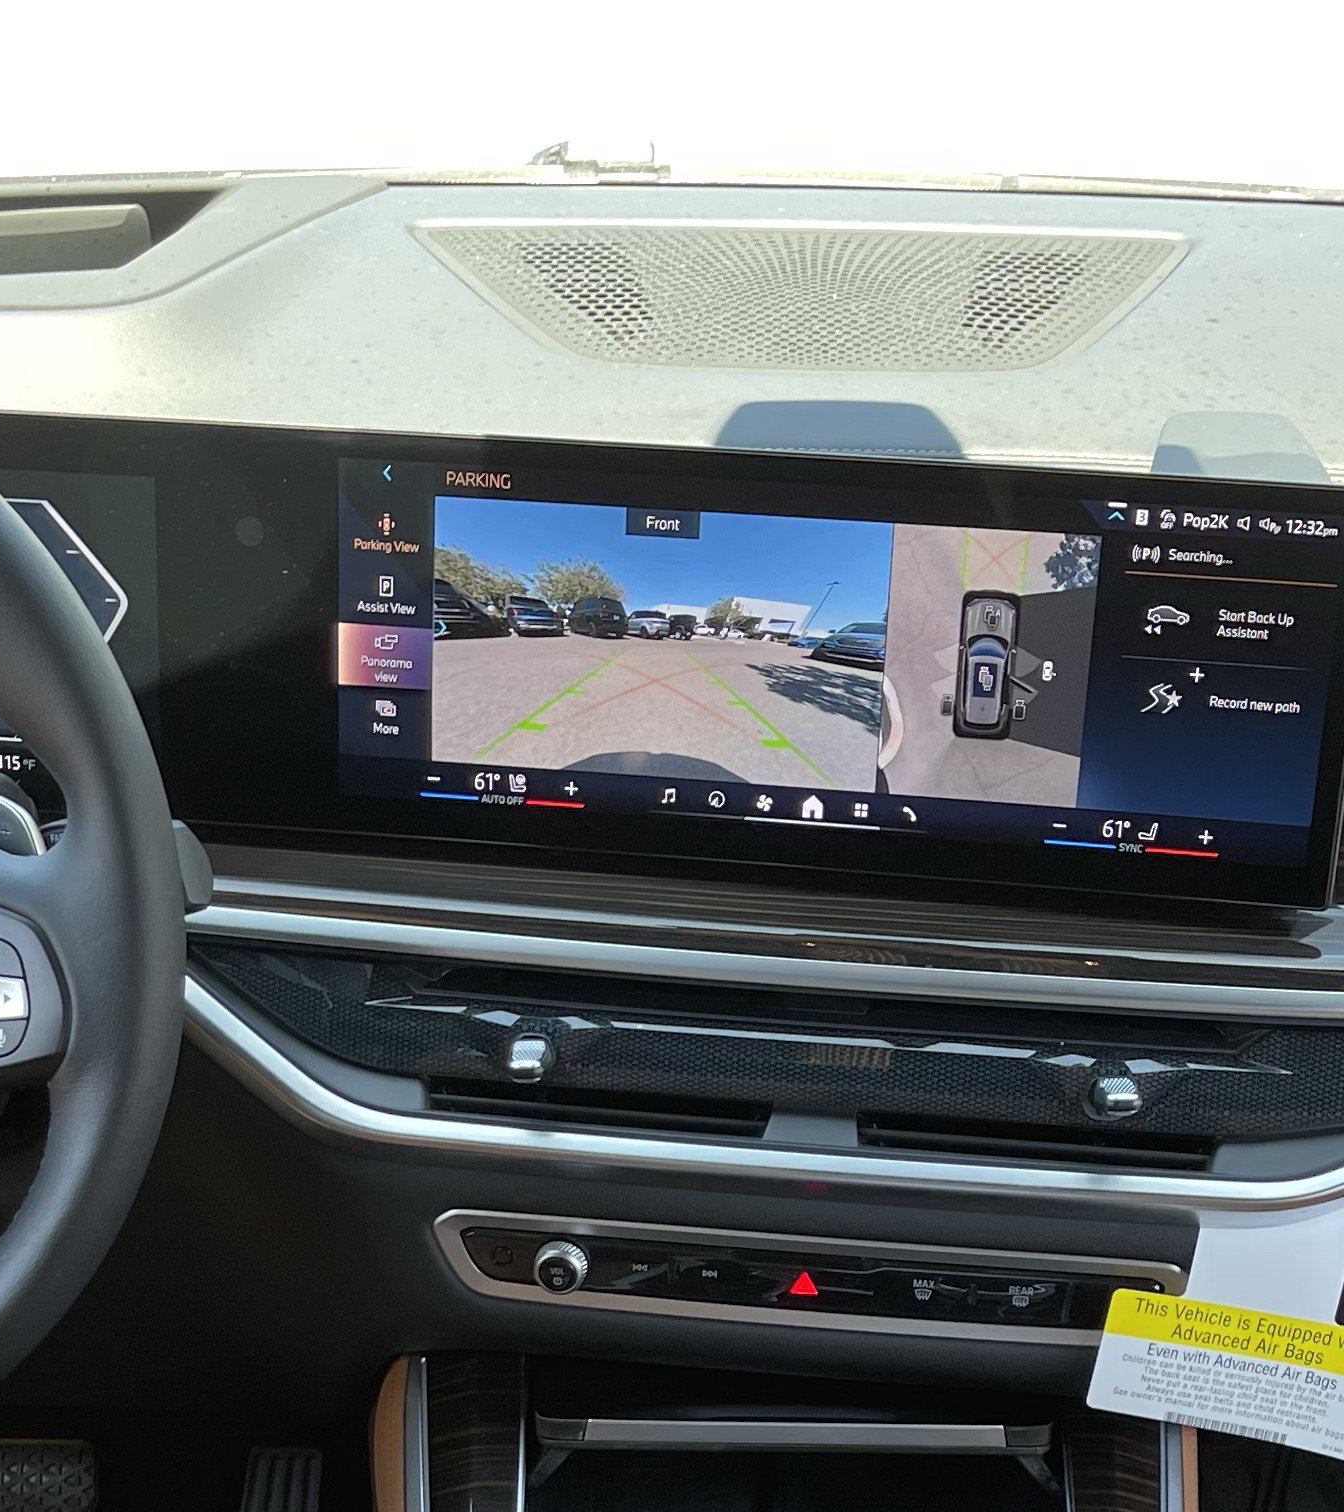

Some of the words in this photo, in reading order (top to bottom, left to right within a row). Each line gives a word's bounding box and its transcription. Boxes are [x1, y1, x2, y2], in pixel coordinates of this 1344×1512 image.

[446, 470, 512, 489] PARKING
[646, 515, 680, 532] Front
[1183, 512, 1229, 531] Pop2K
[1286, 519, 1339, 537] 12:32pm
[354, 537, 392, 554] Parking
[393, 540, 420, 554] View
[1168, 548, 1234, 565] Searching...
[356, 600, 389, 615] Assist
[390, 602, 417, 616] View
[1218, 609, 1246, 624] Start
[1248, 611, 1276, 626] Back
[1277, 613, 1295, 628] Up
[1216, 625, 1269, 640] Assistant
[361, 655, 413, 670] Panorama
[374, 672, 399, 684] view
[1209, 696, 1248, 710] Record
[1249, 700, 1274, 712] new
[1274, 701, 1301, 714] path
[372, 722, 400, 736] More
[474, 772, 501, 791] 61°
[481, 794, 505, 805] AUTO
[506, 796, 525, 806] OFF
[1102, 819, 1132, 839] 61°
[1118, 842, 1144, 854] SYNC
[912, 1278, 935, 1289] MAX
[1008, 1285, 1034, 1297] REAR
[1136, 1297, 1169, 1317] This
[1175, 1303, 1233, 1327] Vehicle
[1237, 1314, 1251, 1331] is
[1256, 1318, 1334, 1346] Equipped
[1170, 1324, 1252, 1350] Advanced
[1255, 1338, 1280, 1356] Air
[1284, 1343, 1325, 1366] Bags
[1147, 1342, 1179, 1360] Even
[1183, 1349, 1210, 1365] with
[1213, 1354, 1279, 1377] Advanced
[1281, 1366, 1302, 1381] Air
[1305, 1371, 1338, 1391] Bags
[1122, 1353, 1157, 1366] Children
[1159, 1361, 1174, 1369] can
[1176, 1362, 1187, 1371] be
[1189, 1365, 1211, 1375] killed
[1213, 1368, 1223, 1377] or
[1225, 1372, 1263, 1385] seriously
[1264, 1379, 1295, 1391] injured
[1297, 1384, 1307, 1396] by
[1309, 1387, 1323, 1397] the
[1324, 1391, 1337, 1400] air
[1144, 1365, 1159, 1376] The
[1161, 1368, 1181, 1379] back
[1182, 1373, 1201, 1382] seat
[1202, 1376, 1210, 1384] is
[1212, 1377, 1226, 1386] the
[1227, 1380, 1253, 1392] safest
[1255, 1385, 1277, 1396] place
[1279, 1389, 1292, 1399] for
[1140, 1374, 1165, 1385] Never
[1166, 1379, 1181, 1389] put
[1190, 1384, 1235, 1399] rear-facing
[1237, 1390, 1258, 1401] child
[1260, 1396, 1277, 1406] seat
[1279, 1399, 1288, 1408] in
[1290, 1401, 1304, 1411] the
[1145, 1384, 1175, 1397] Always
[1194, 1393, 1212, 1402] seat
[1214, 1396, 1234, 1407] belts
[1236, 1399, 1252, 1410] and
[1254, 1402, 1275, 1414] child
[1112, 1386, 1129, 1397] See
[1164, 1397, 1195, 1409] manual
[1196, 1400, 1210, 1410] for
[1211, 1405, 1233, 1416] more
[1234, 1408, 1283, 1425] information
[1285, 1419, 1310, 1432] about
[1311, 1425, 1323, 1434] air
